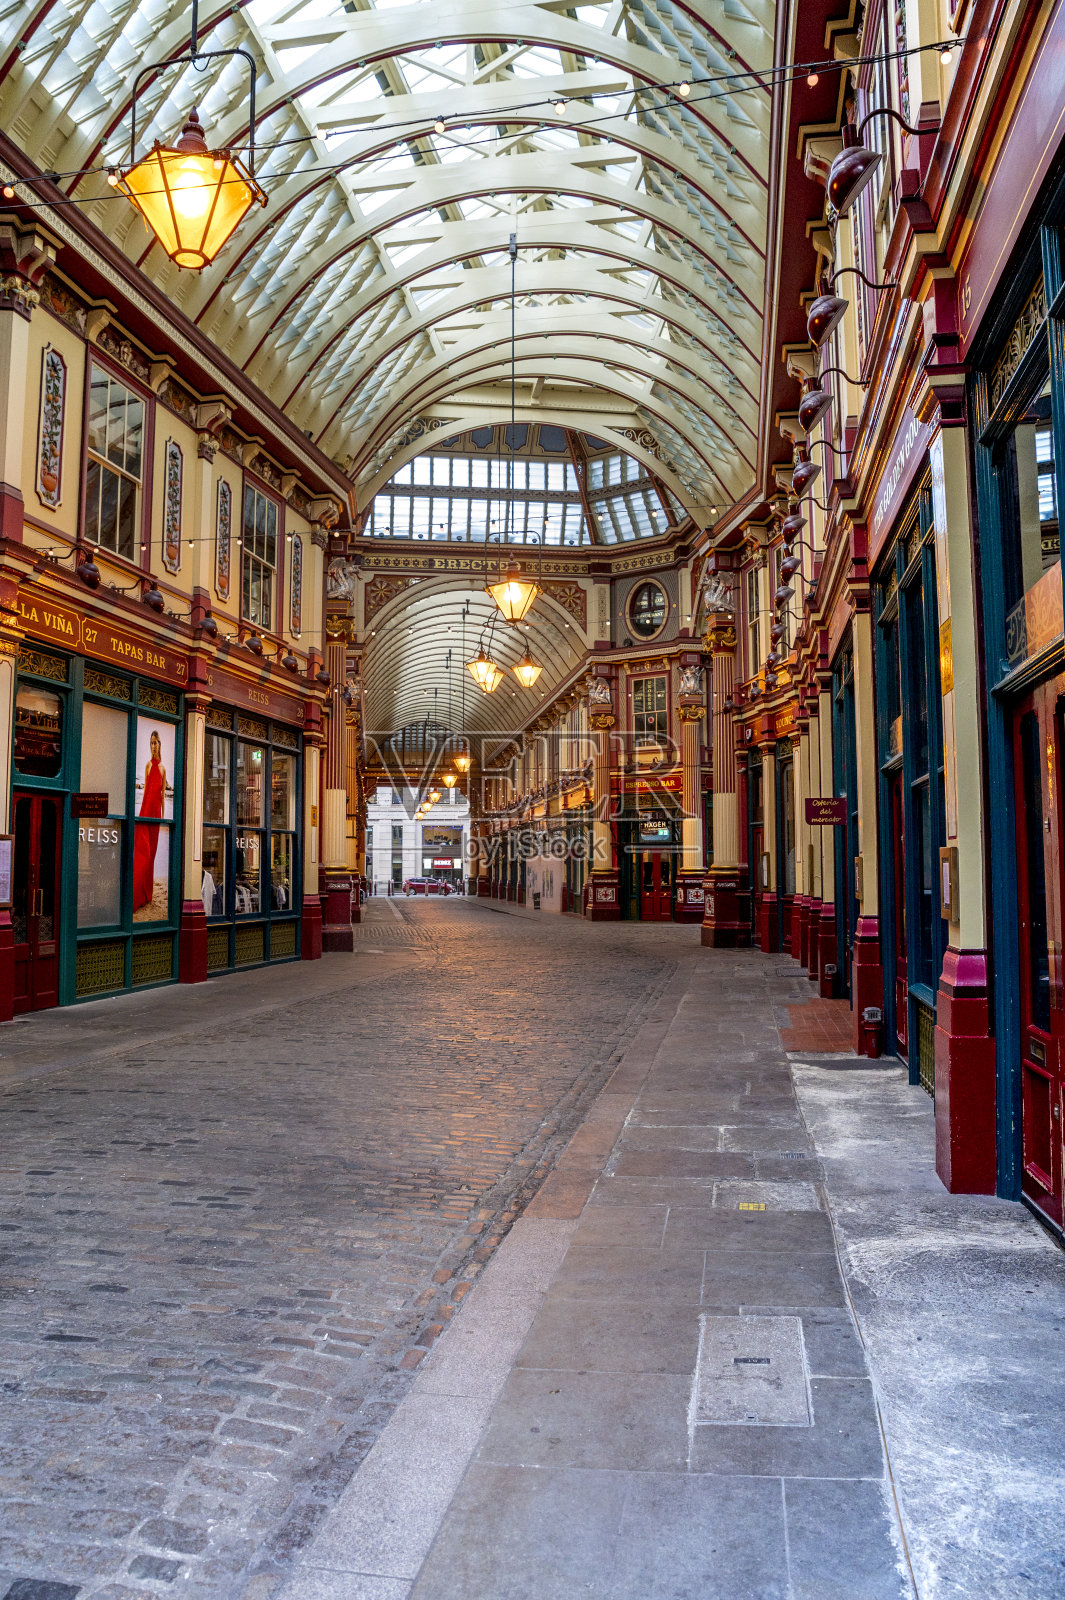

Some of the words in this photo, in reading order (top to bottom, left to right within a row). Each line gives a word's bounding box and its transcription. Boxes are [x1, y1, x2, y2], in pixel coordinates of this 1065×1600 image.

[962, 273, 971, 320] 15
[883, 443, 906, 513] GOLDEN
[20, 602, 40, 623] LA
[43, 611, 74, 636] VIÑA
[85, 627, 98, 644] 27
[110, 637, 144, 661] TAPAS
[146, 651, 166, 670] BAR
[176, 662, 186, 676] 27
[248, 688, 269, 706] REISS
[625, 780, 660, 789] ESPRESSO
[661, 779, 676, 787] BAR
[812, 799, 839, 807] Osteria
[78, 827, 118, 844] REISS
[235, 837, 260, 850] REISS
